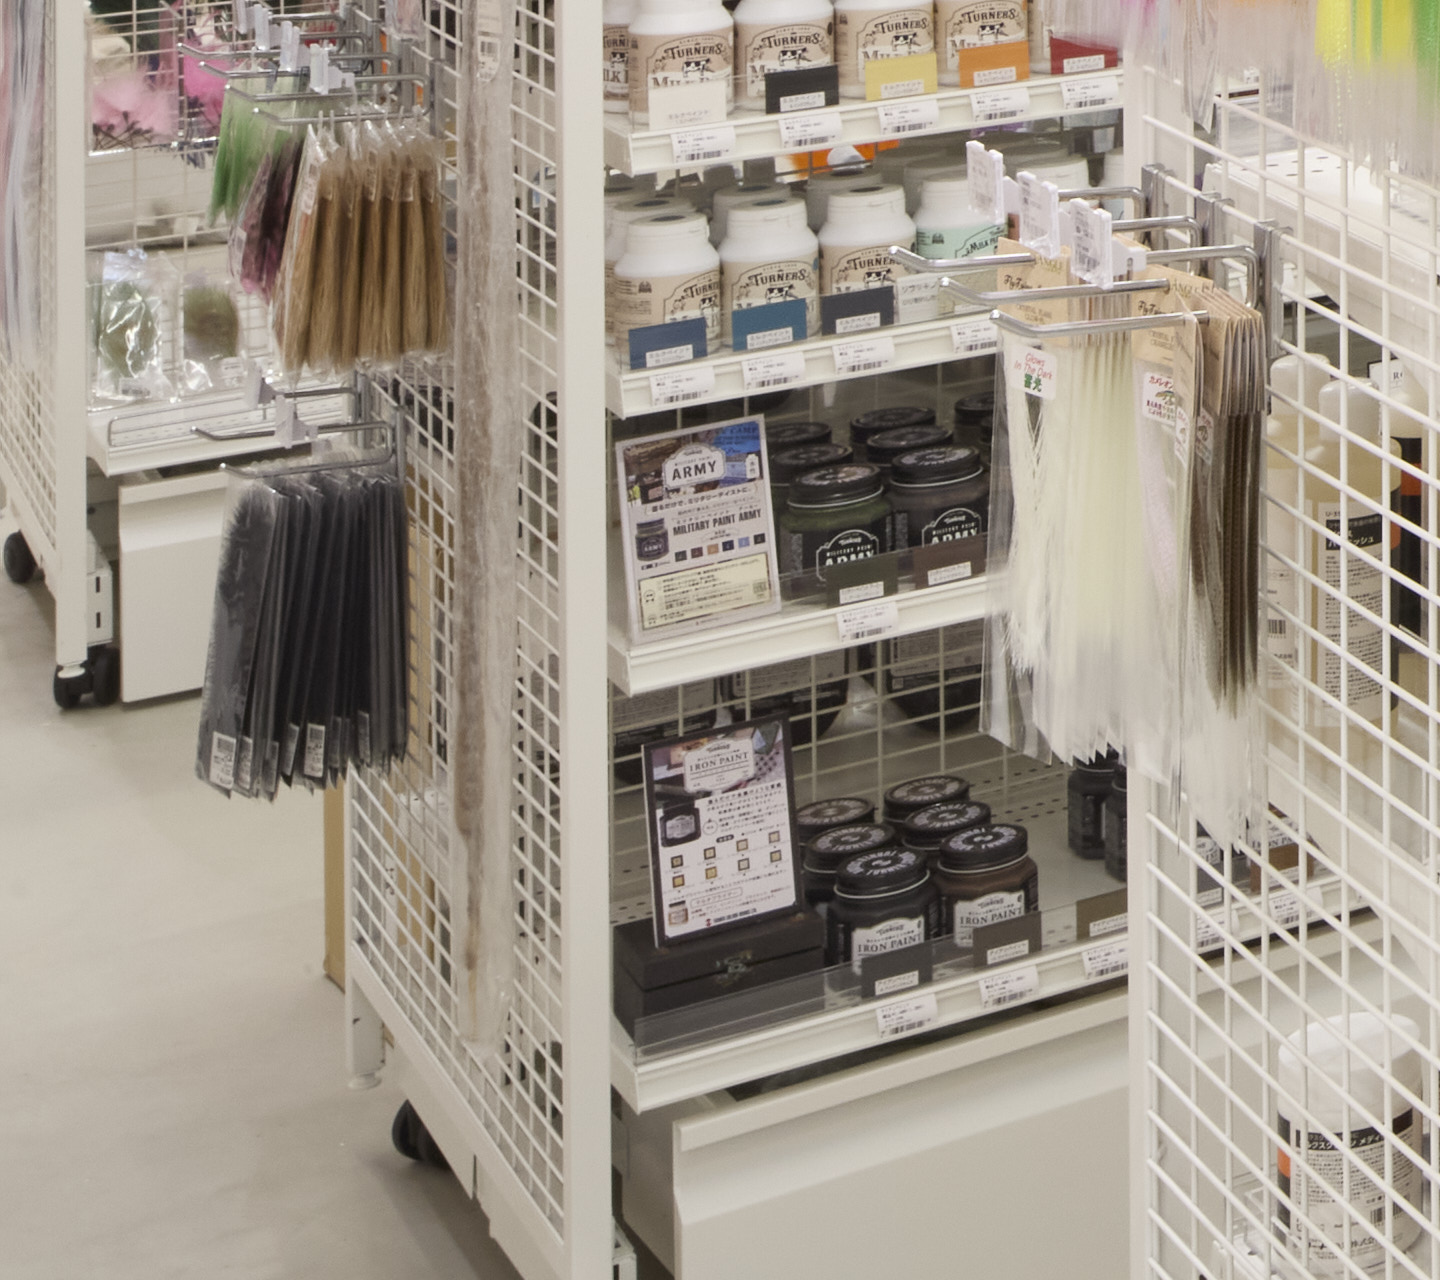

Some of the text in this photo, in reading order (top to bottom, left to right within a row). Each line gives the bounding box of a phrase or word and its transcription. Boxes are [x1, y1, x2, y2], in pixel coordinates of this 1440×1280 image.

[1024, 363, 1038, 375] The
[1025, 352, 1046, 368] Glows
[671, 460, 718, 482] ARMY
[673, 508, 762, 536] MILITARY PAINT ARMY
[688, 751, 749, 773] IRON PAINT
[959, 907, 1022, 926] IRON PAINT
[857, 934, 922, 954] IRON PAINT
